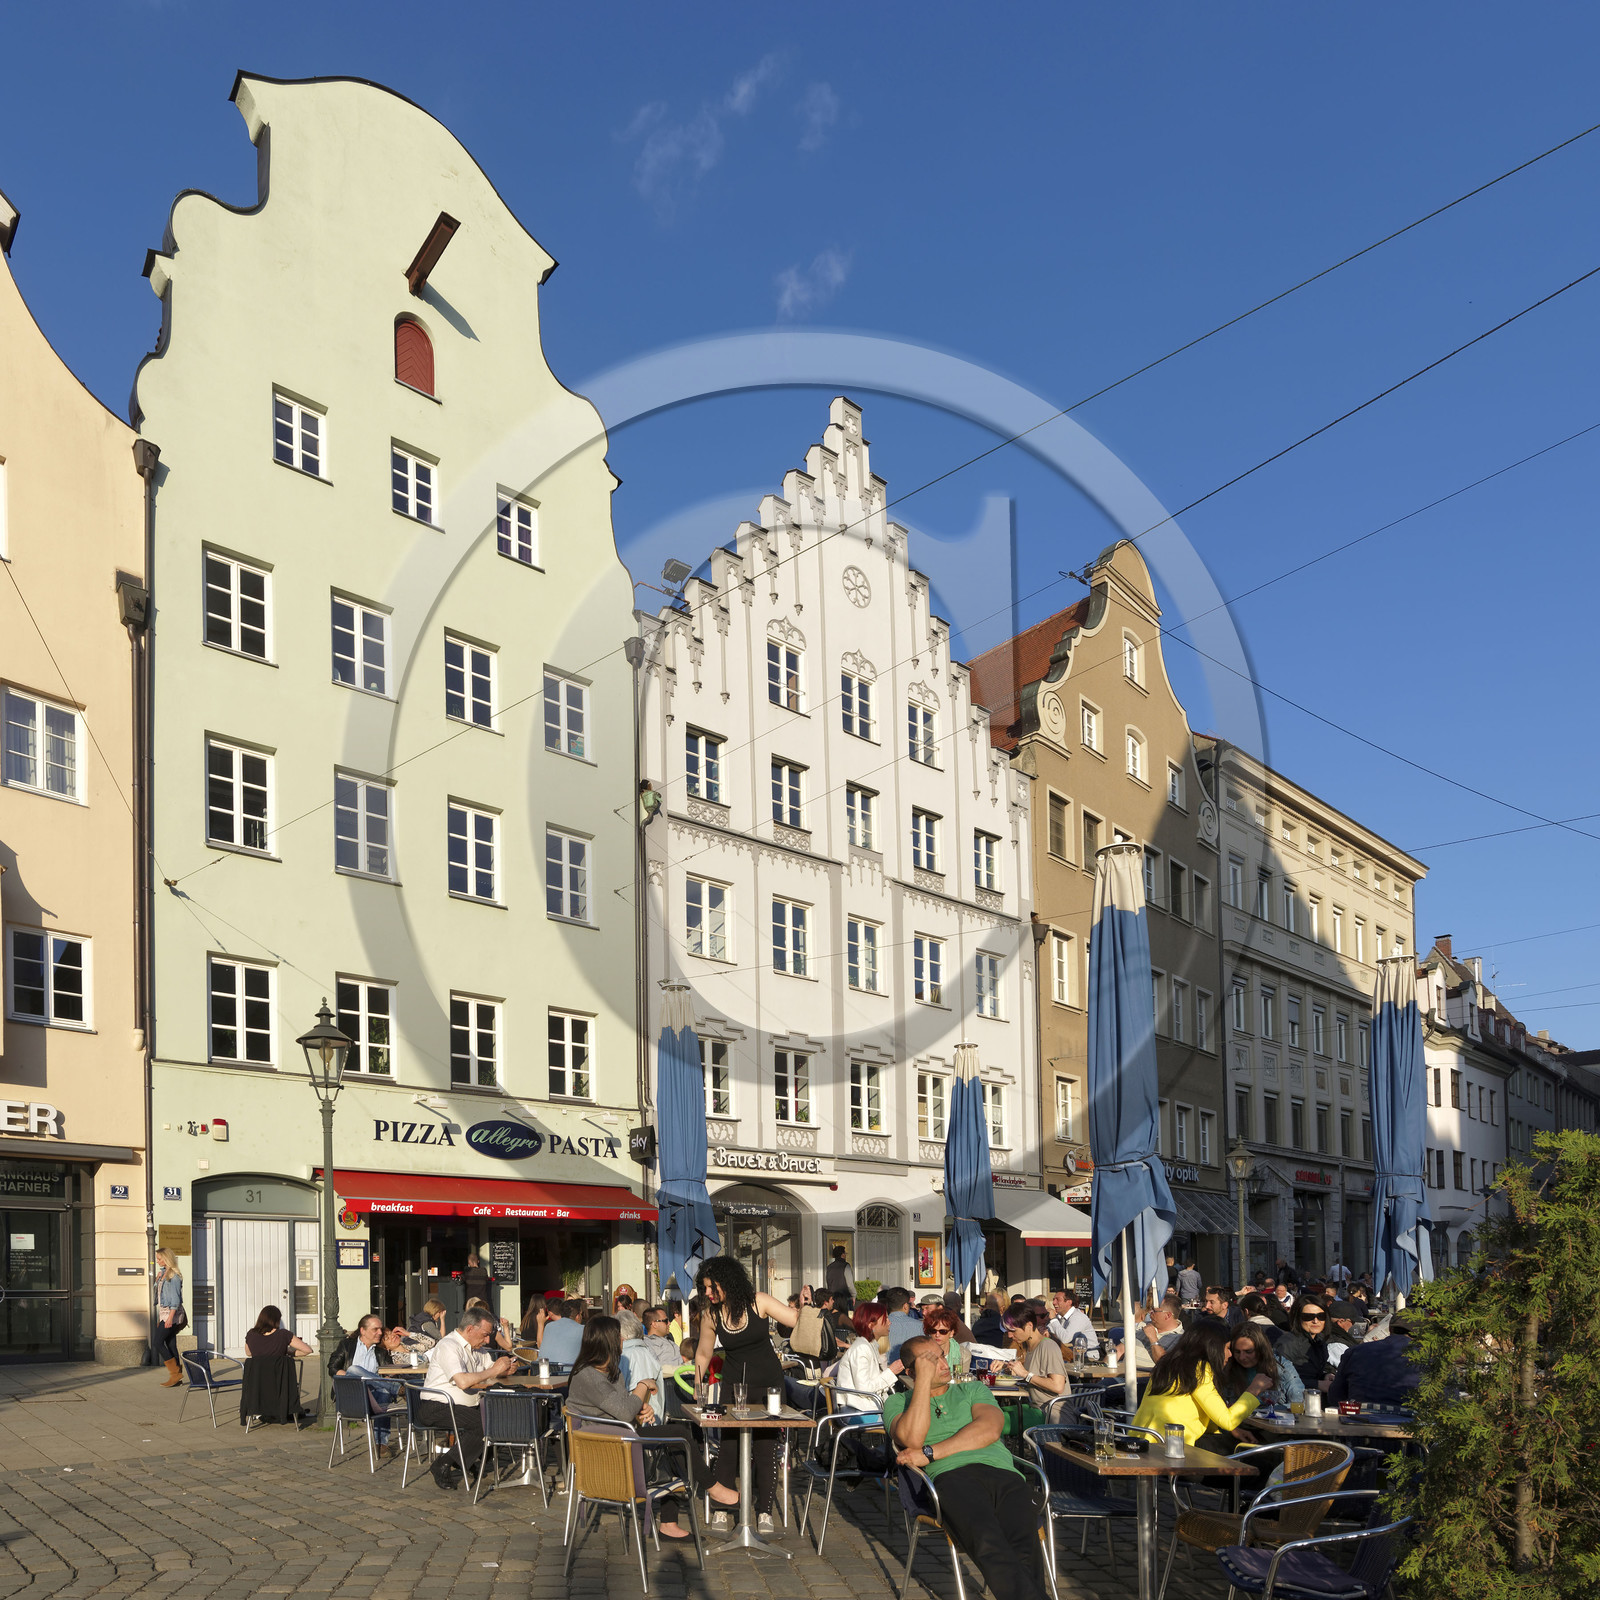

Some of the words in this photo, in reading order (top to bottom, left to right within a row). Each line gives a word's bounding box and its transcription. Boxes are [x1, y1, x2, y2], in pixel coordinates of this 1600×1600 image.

[0, 1099, 58, 1135] ER
[373, 1119, 456, 1146] PIZZA
[471, 1126, 539, 1153] allegro
[548, 1133, 618, 1158] PASTA
[631, 1135, 648, 1150] sky
[1176, 1165, 1201, 1184] optik
[115, 1186, 125, 1195] 29
[166, 1187, 178, 1196] 31
[245, 1189, 262, 1204] 31
[370, 1202, 414, 1213] breakfast
[505, 1207, 547, 1217] Restaurant
[556, 1209, 570, 1218] Bar
[619, 1211, 641, 1220] drinks
